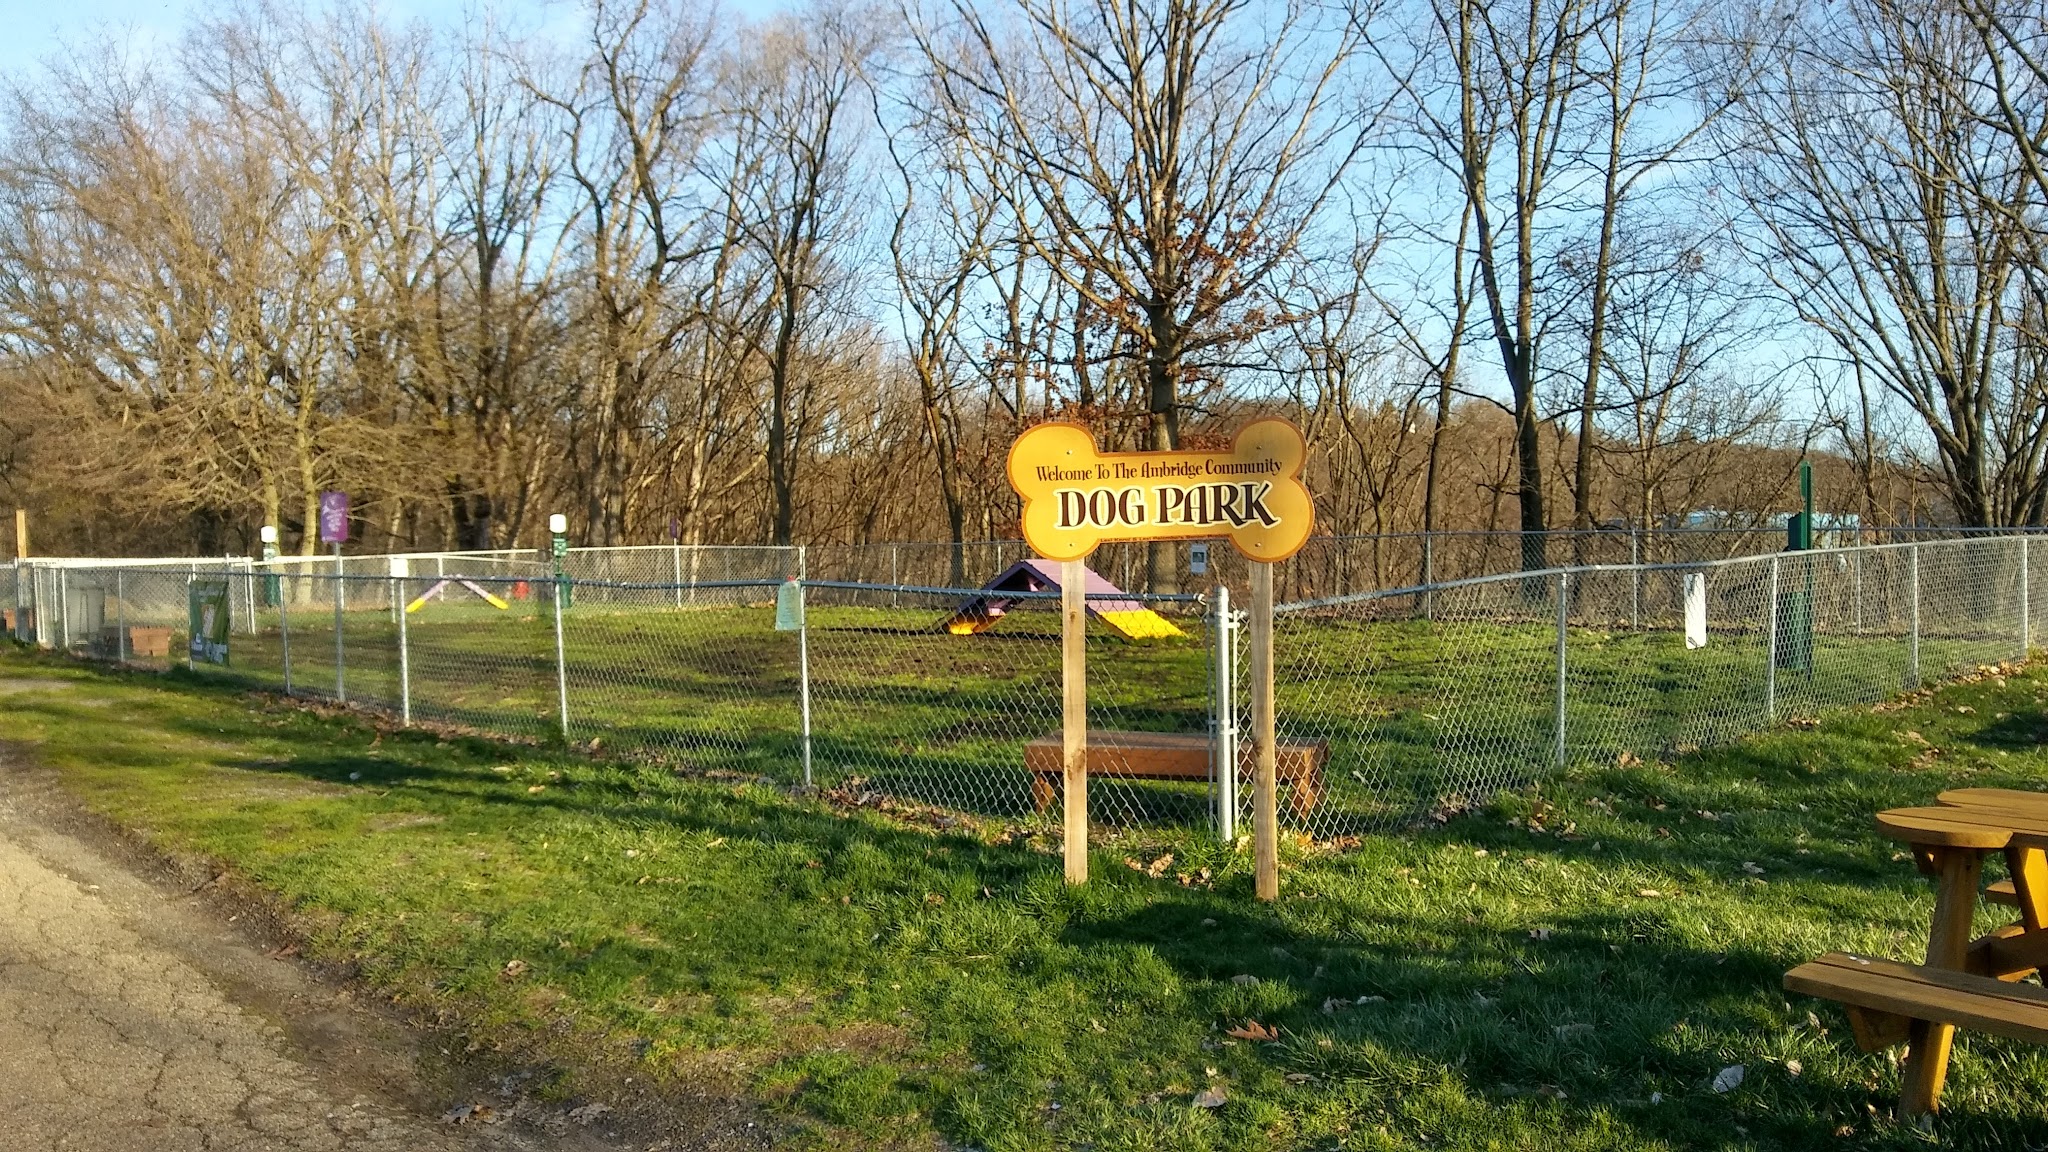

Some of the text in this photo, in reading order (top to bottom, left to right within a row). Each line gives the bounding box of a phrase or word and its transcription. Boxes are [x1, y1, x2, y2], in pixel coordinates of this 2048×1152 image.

[1036, 458, 1283, 482] Welcome To The Ambridge Community
[1057, 483, 1279, 528] DOG PARK
